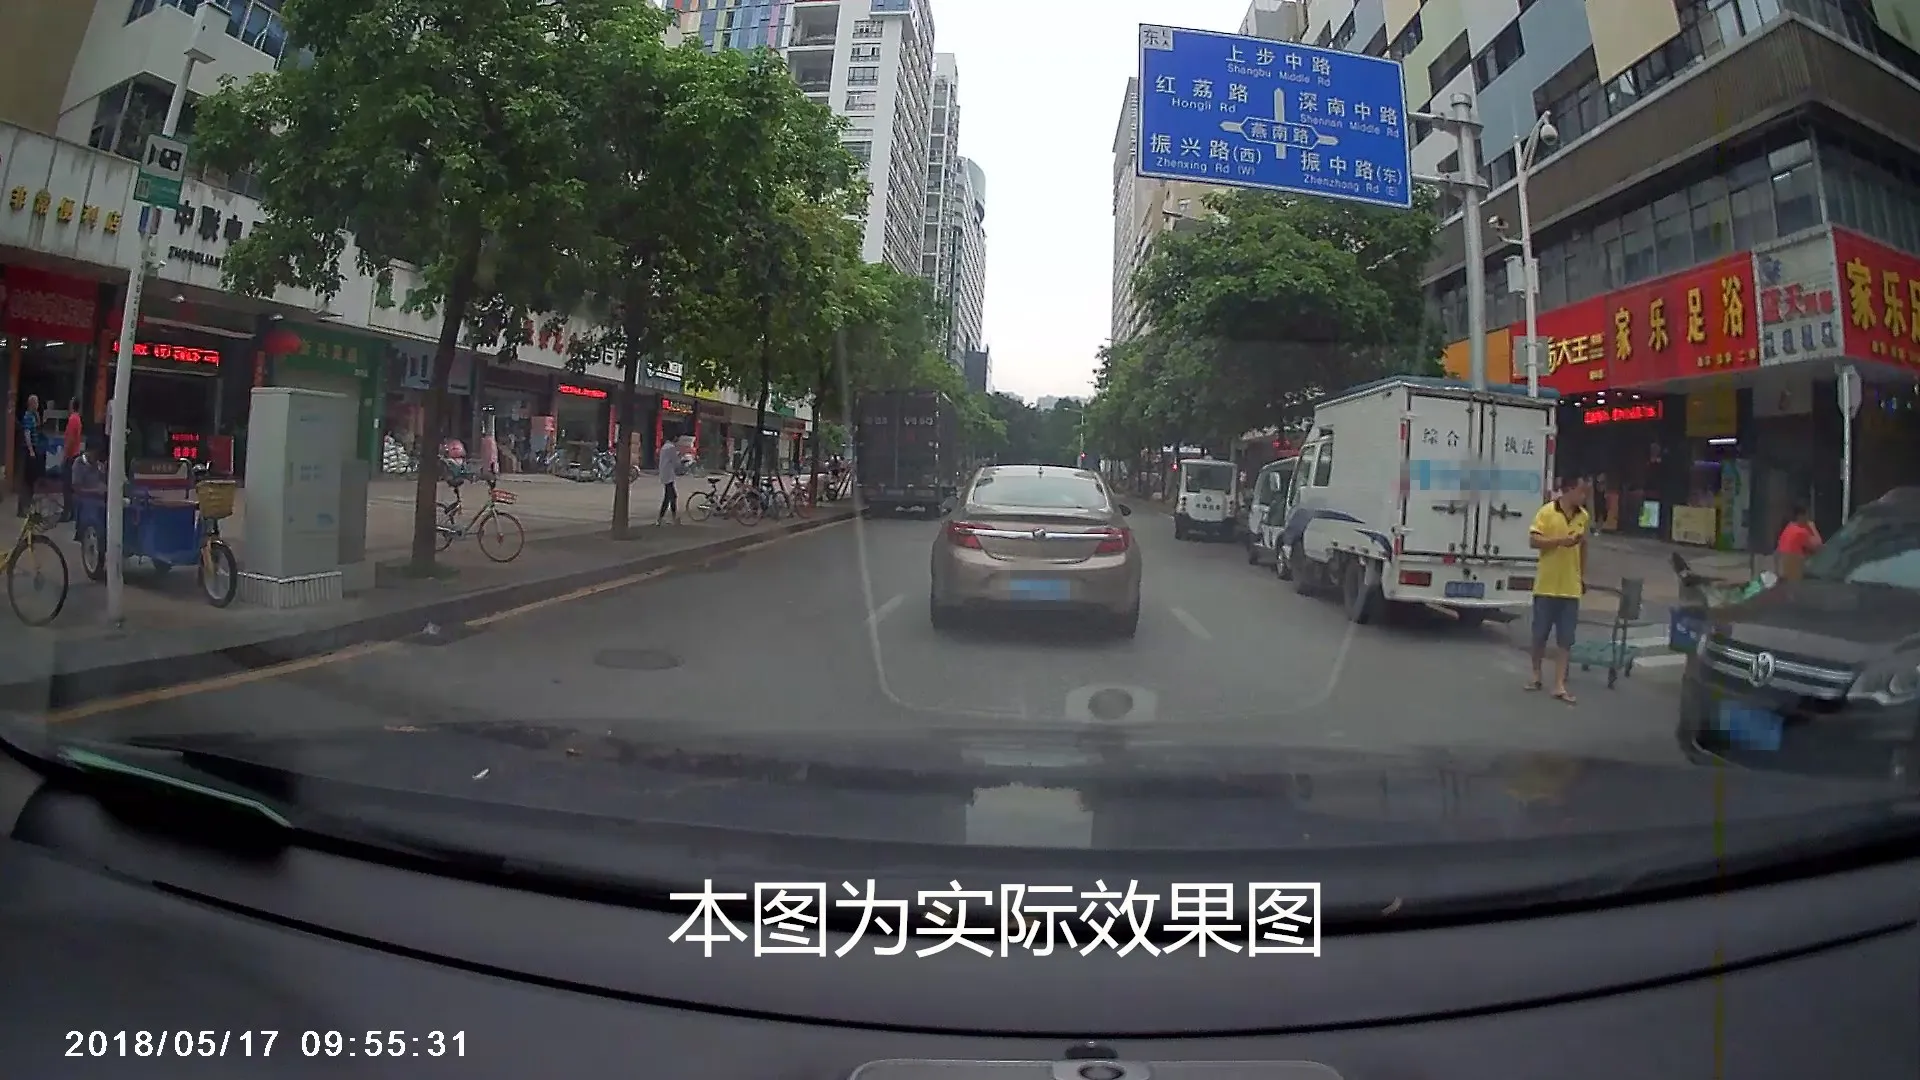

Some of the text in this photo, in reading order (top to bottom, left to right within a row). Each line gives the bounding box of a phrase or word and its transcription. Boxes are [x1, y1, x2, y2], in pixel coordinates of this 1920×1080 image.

[1143, 28, 1159, 45] 东
[1225, 44, 1331, 76] 上步中路
[1154, 74, 1249, 104] 红荔路
[1226, 63, 1331, 87] Shangbu Middle Rd
[1171, 97, 1236, 113] Hongli Rd
[1298, 91, 1398, 126] 深南中路
[1250, 121, 1309, 146] 燕南路
[1300, 113, 1400, 139] Shennan Middle Rd
[1149, 132, 1262, 164] 振兴路(西)
[1155, 156, 1207, 173] Zhenxing
[1215, 162, 1230, 174] Rd
[1300, 149, 1403, 185] 振中路(东)
[1303, 173, 1360, 193] Zhenzhong
[1365, 182, 1380, 195] Rd
[9, 184, 122, 235] 非常便利店
[174, 199, 266, 247] 中联电
[1614, 274, 1744, 361] 家乐足浴
[1421, 427, 1536, 455] 综合 执法
